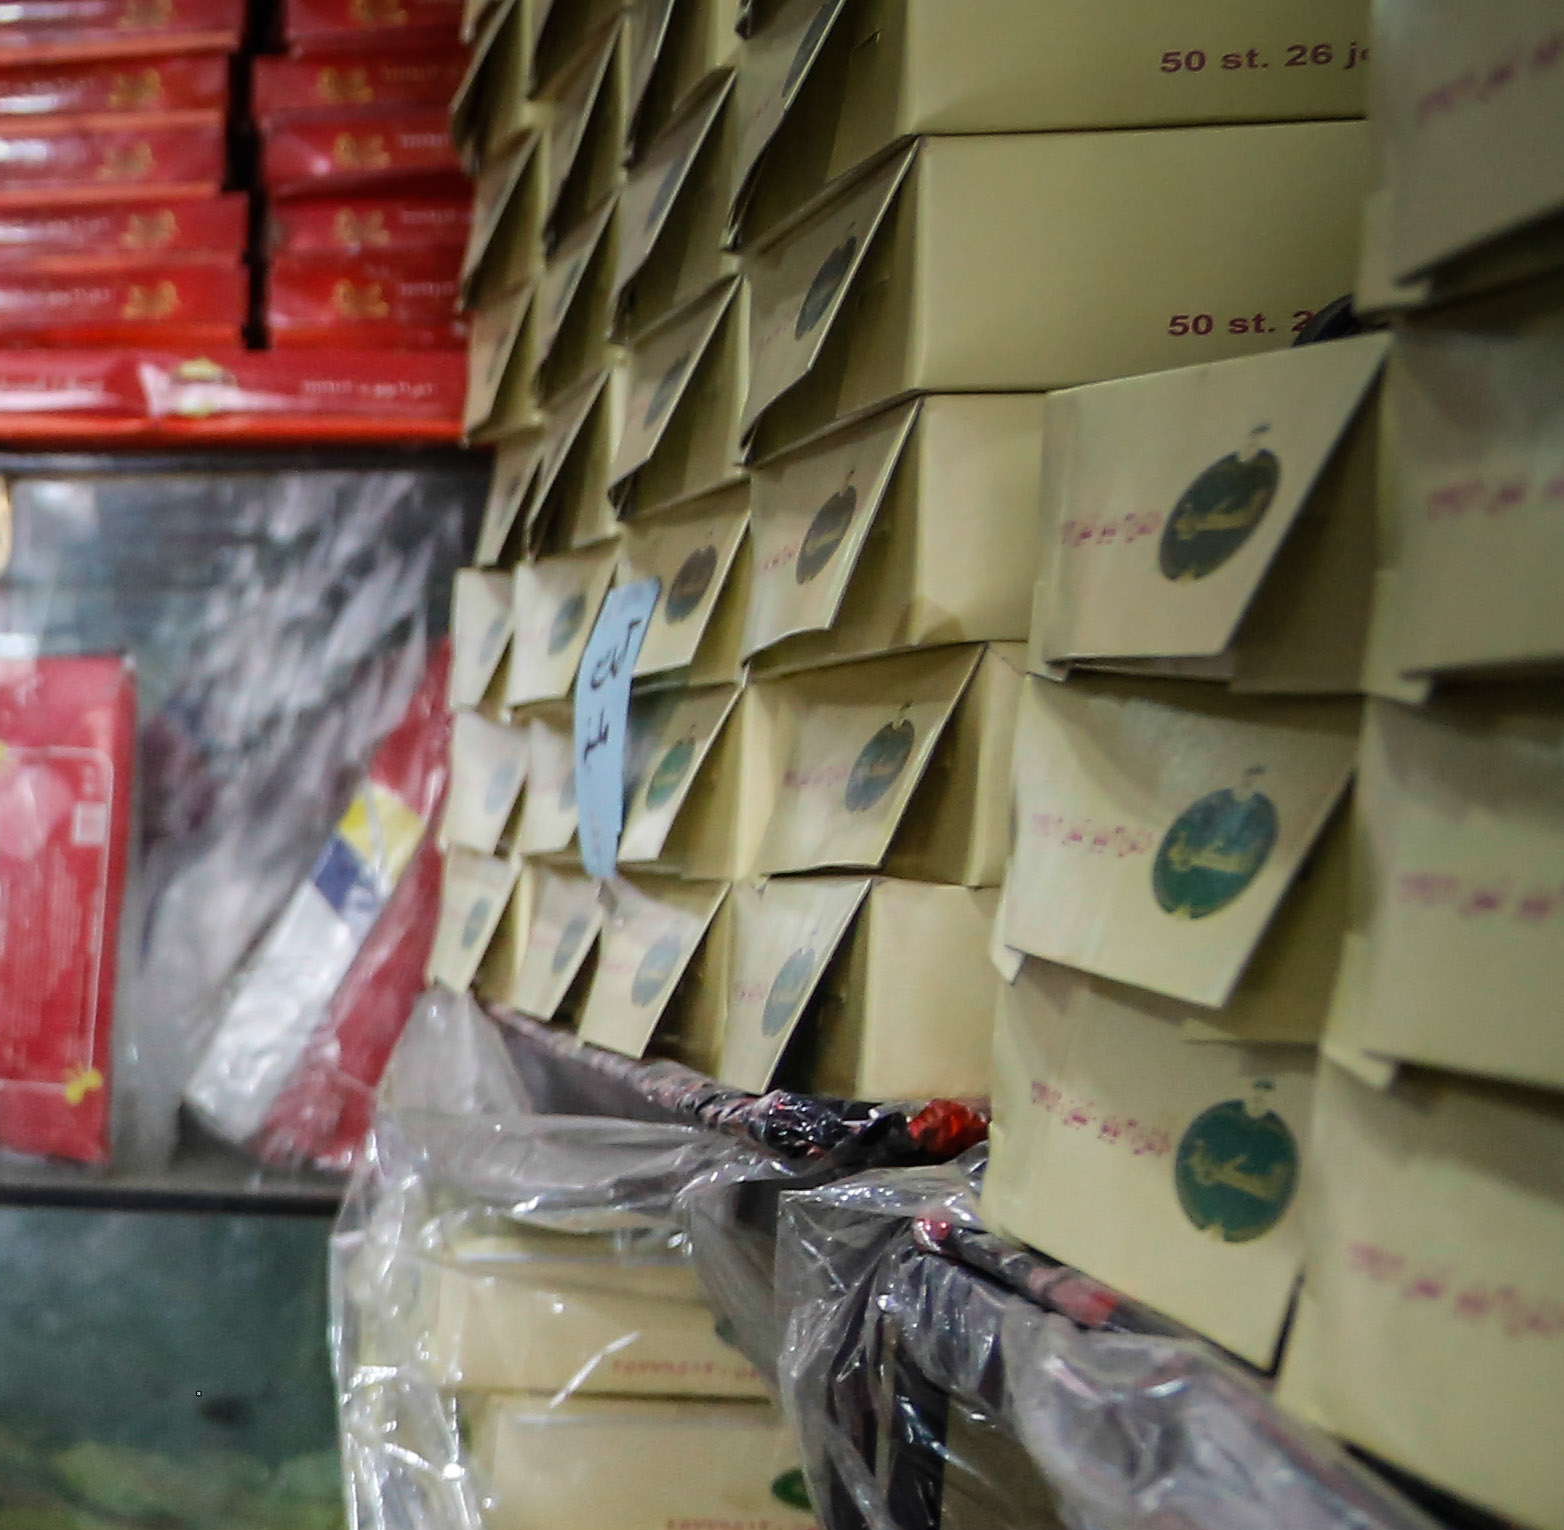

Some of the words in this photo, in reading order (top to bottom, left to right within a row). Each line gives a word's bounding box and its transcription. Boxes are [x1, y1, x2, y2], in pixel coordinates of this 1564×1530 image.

[1160, 50, 1207, 74] 50
[1221, 49, 1270, 71] st.
[1284, 43, 1334, 68] 26
[1168, 313, 1214, 337] 50
[1228, 312, 1276, 334] st.
[1291, 309, 1317, 334] 2
